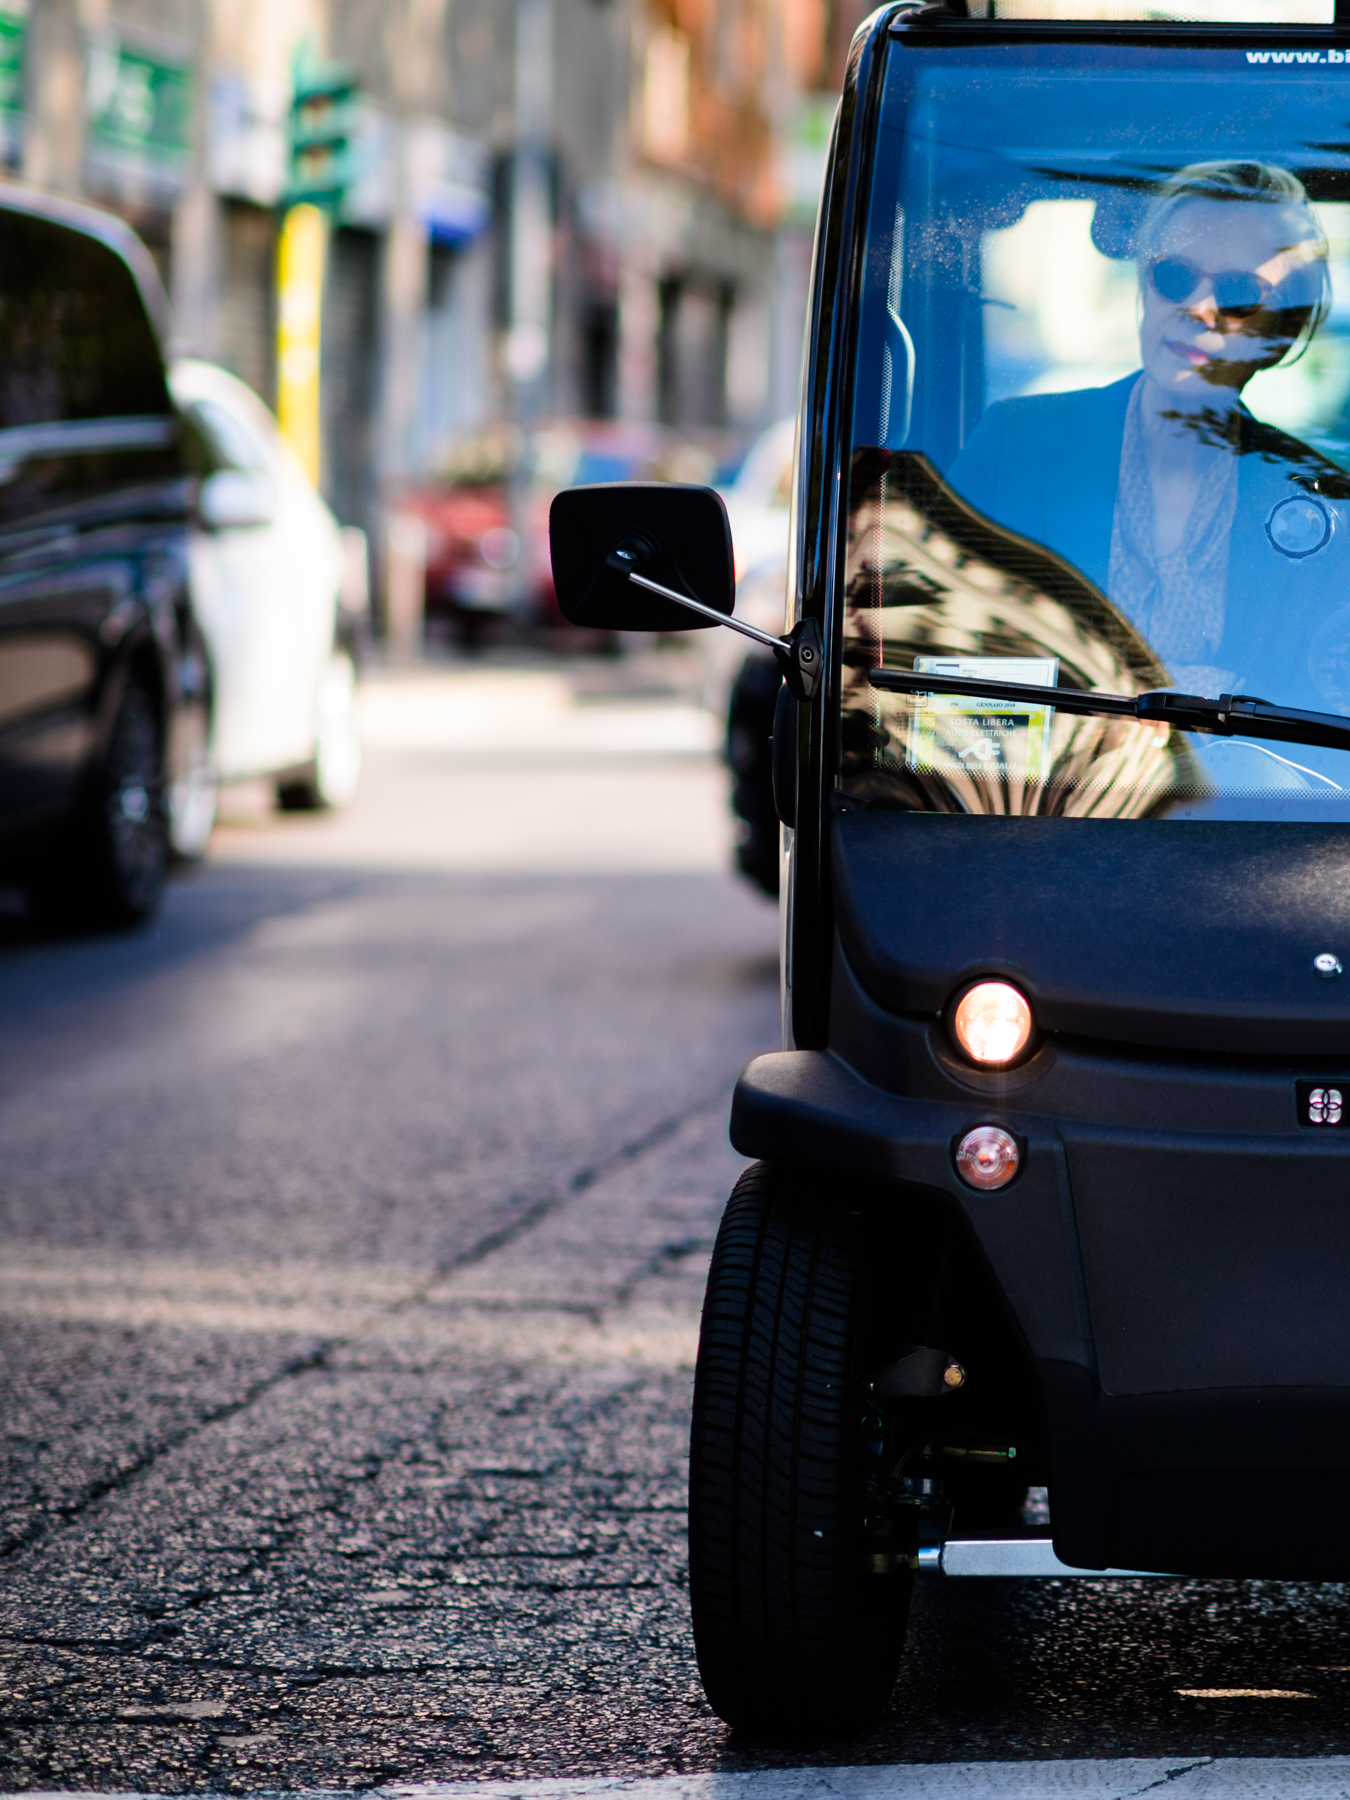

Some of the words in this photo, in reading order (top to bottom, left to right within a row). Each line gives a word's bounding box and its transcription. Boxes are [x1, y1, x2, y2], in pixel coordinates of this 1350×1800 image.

[949, 718, 979, 726] SOSTA
[982, 718, 1015, 726] LIBERA
[945, 729, 968, 737] AUTO
[971, 729, 1017, 737] ELETTRICHE
[943, 762, 964, 770] SPAZI
[966, 762, 982, 770] BLU
[983, 762, 989, 770] E
[990, 762, 1016, 770] GIALLI
